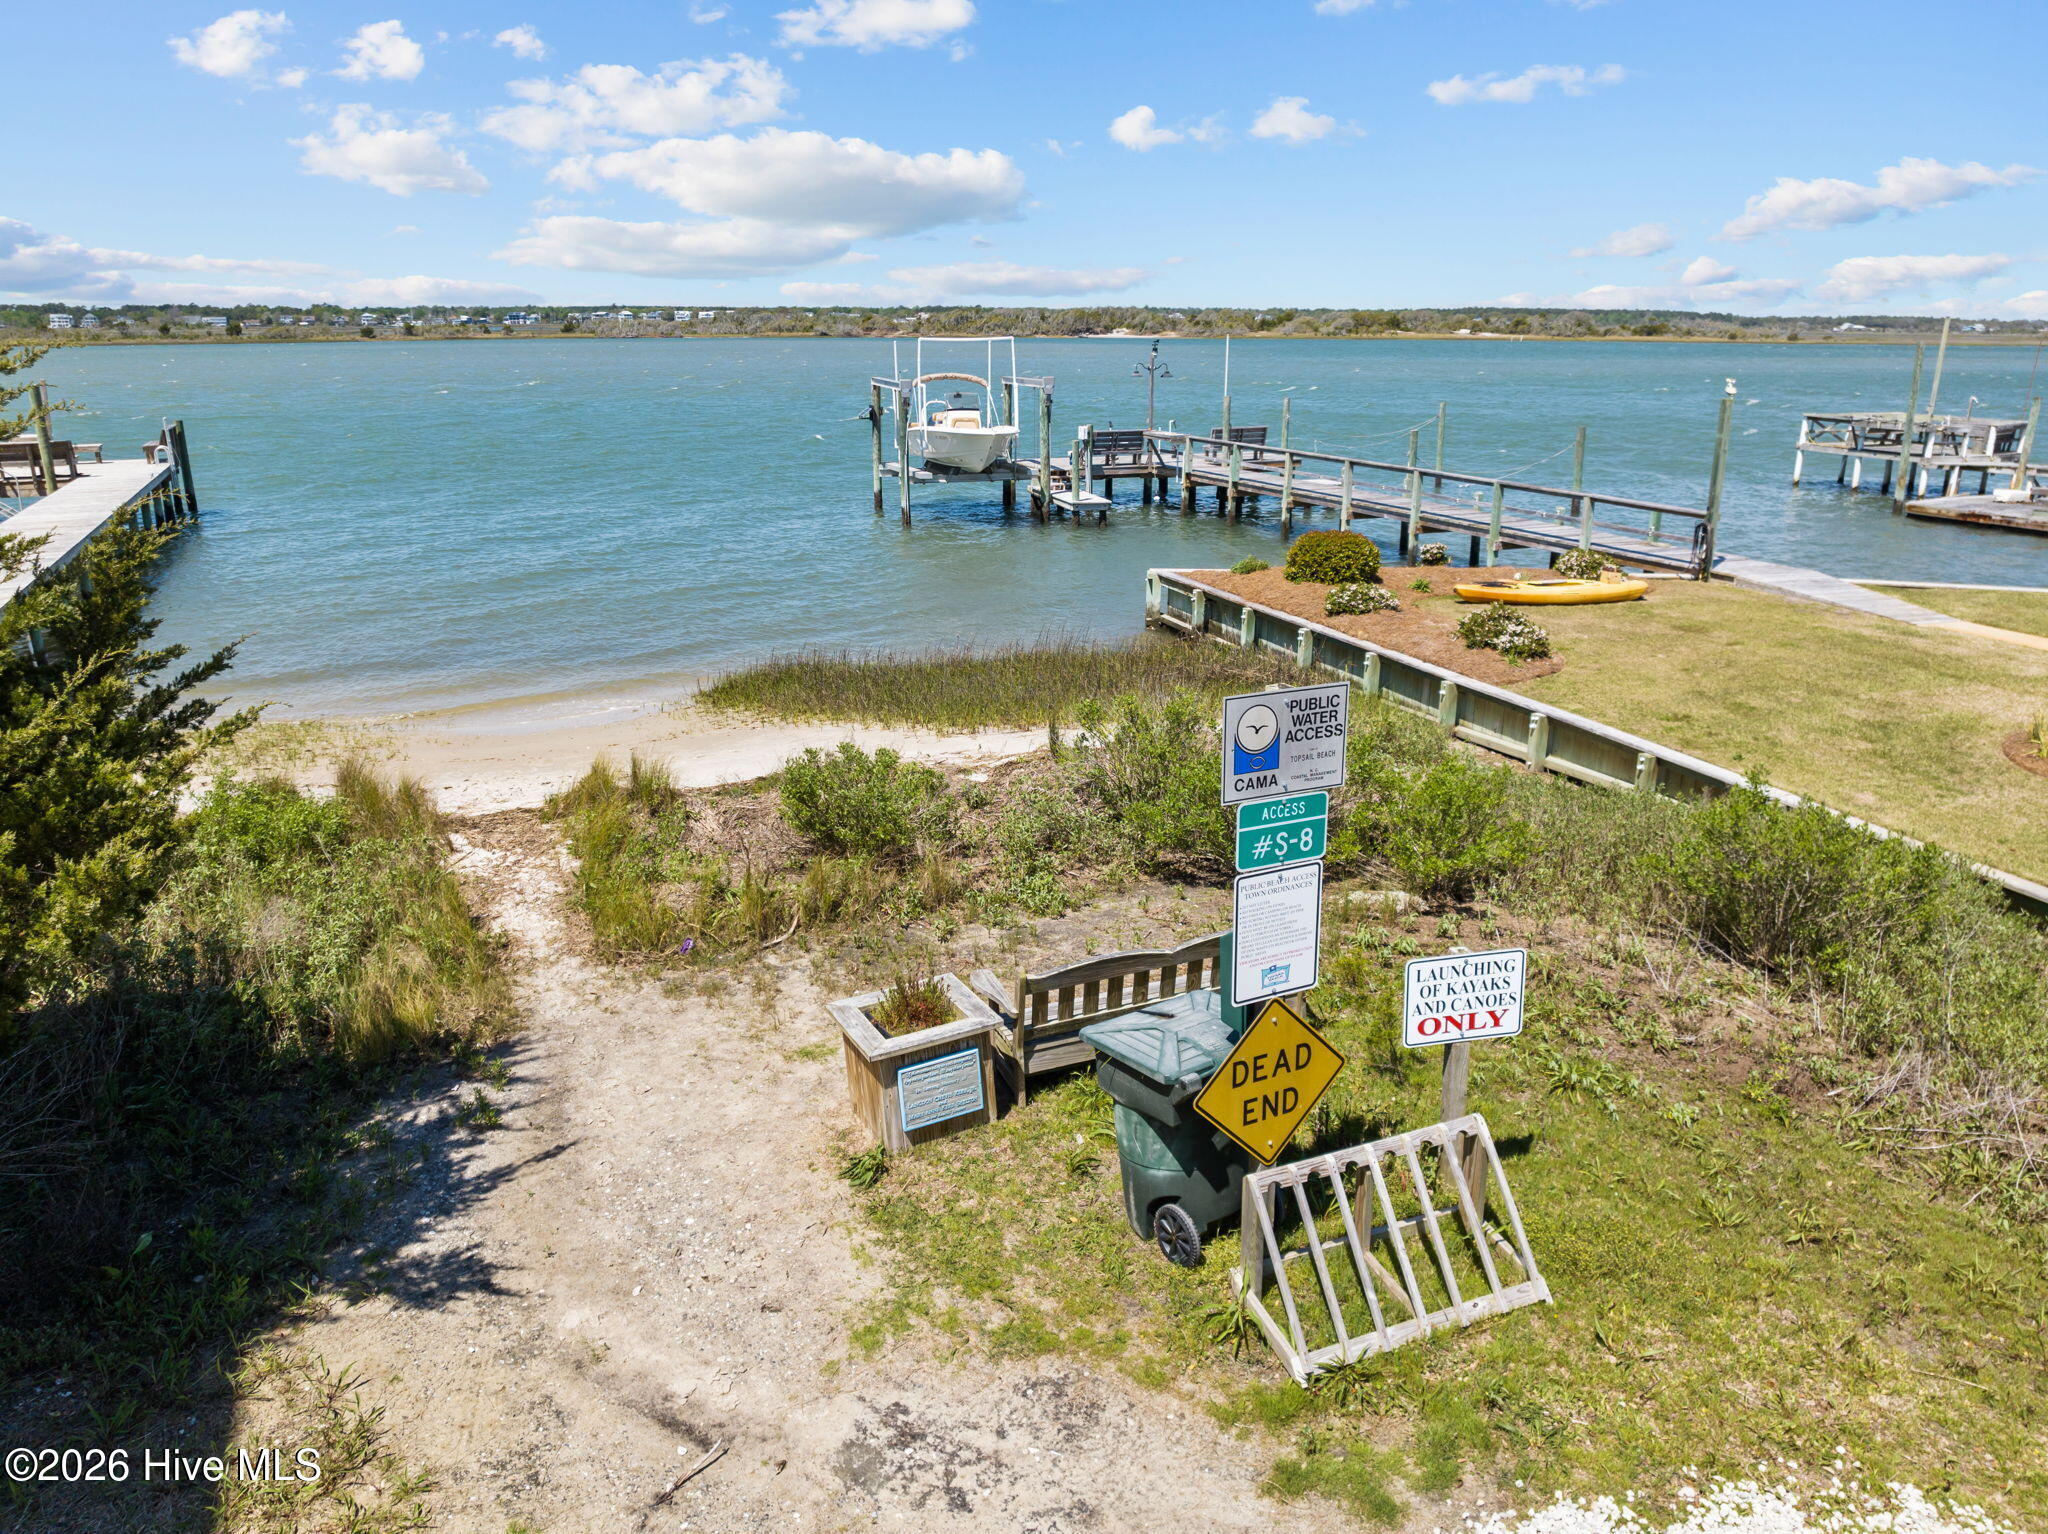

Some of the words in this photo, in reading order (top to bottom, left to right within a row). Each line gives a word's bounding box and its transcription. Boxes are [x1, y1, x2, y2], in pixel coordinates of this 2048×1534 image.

[1290, 695, 1340, 713] PUBLIC
[1292, 710, 1338, 728] WATER
[1285, 724, 1343, 743] ACCESS
[1290, 753, 1314, 763] TOPSAIL
[1317, 750, 1336, 759] BEACH
[1234, 774, 1278, 792] CAMA
[1262, 802, 1306, 820] ACCESS
[1252, 828, 1313, 859] #S-8
[1240, 882, 1265, 893] PUBLIC
[1267, 877, 1290, 887] BEACH
[1293, 872, 1317, 882] ACCESS
[1245, 890, 1266, 900] TOWN
[1268, 881, 1313, 895] ORDINANCES
[1417, 959, 1516, 983] LAUNCHING
[1420, 984, 1442, 999] OF
[1447, 976, 1511, 996] KAYAKS
[1412, 1000, 1446, 1017] AND
[1451, 992, 1517, 1012] CANOES
[1417, 1009, 1510, 1036] ONLY
[1232, 1042, 1312, 1089] DEAD
[1242, 1087, 1299, 1127] END
